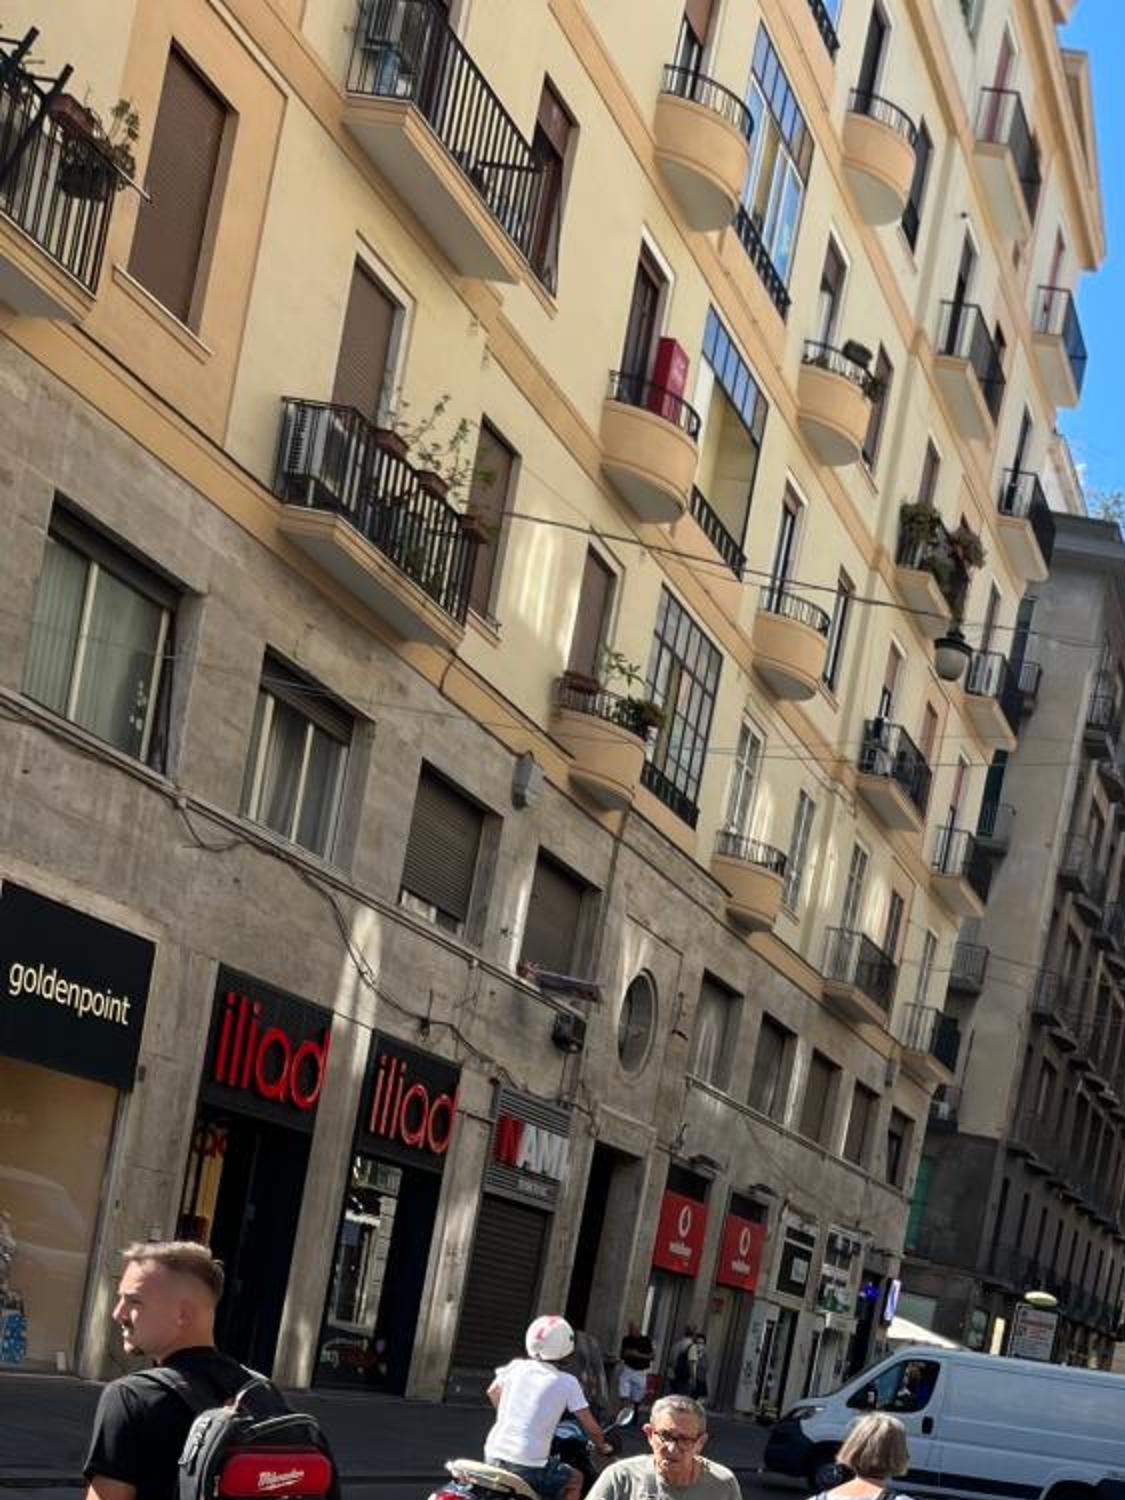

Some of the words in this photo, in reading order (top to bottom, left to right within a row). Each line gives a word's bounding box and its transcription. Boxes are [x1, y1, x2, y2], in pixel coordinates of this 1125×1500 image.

[9, 962, 131, 1025] goldenpoint
[214, 991, 331, 1110] iliad
[369, 1055, 462, 1153] iliad
